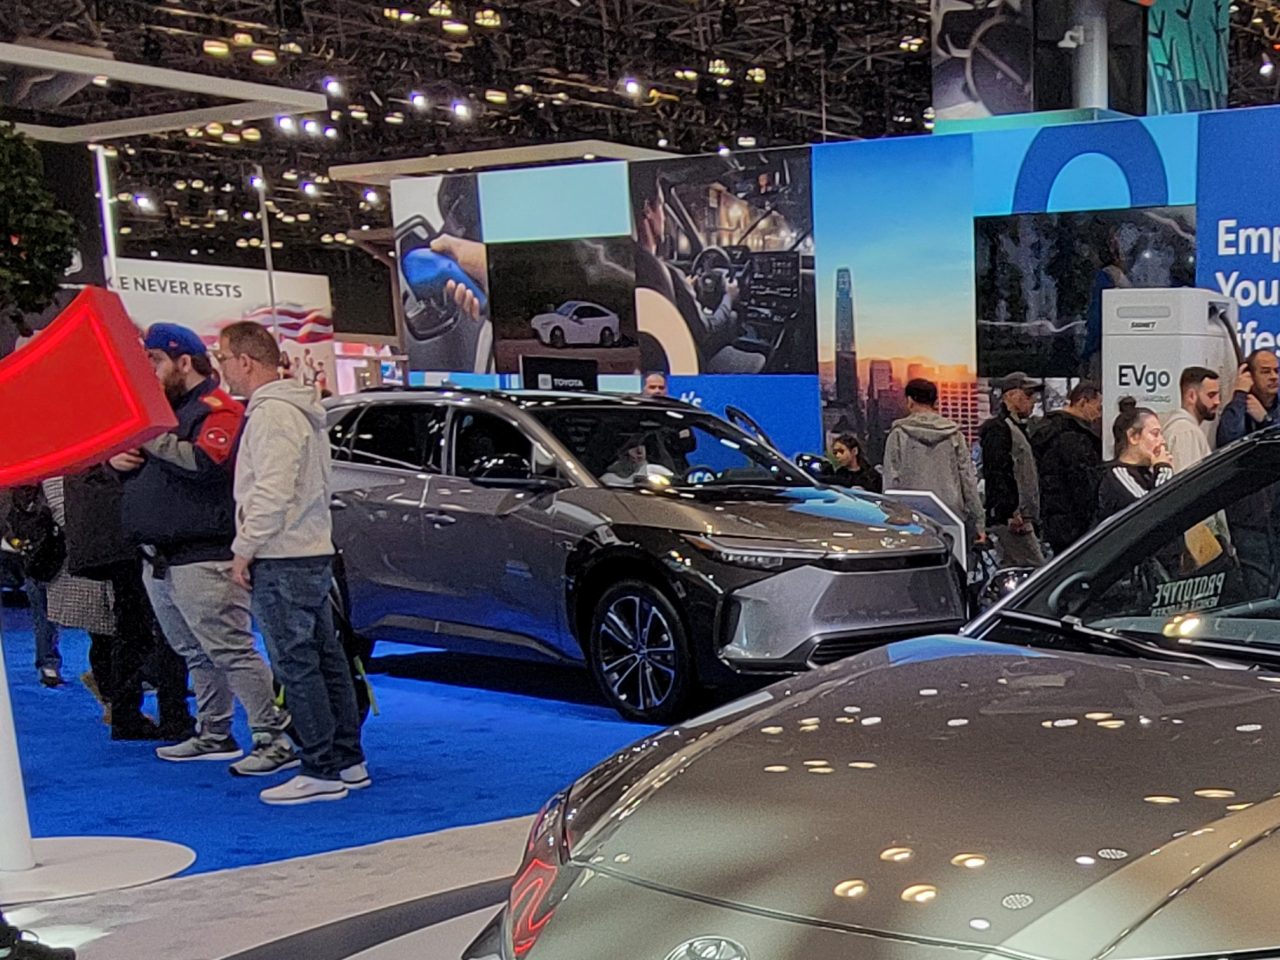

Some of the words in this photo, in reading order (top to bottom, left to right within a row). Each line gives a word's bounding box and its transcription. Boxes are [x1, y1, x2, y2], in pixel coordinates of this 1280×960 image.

[134, 277, 189, 295] NEVER
[194, 282, 242, 298] RESTS
[553, 378, 584, 387] TOYOTA
[1118, 364, 1171, 393] EVgo
